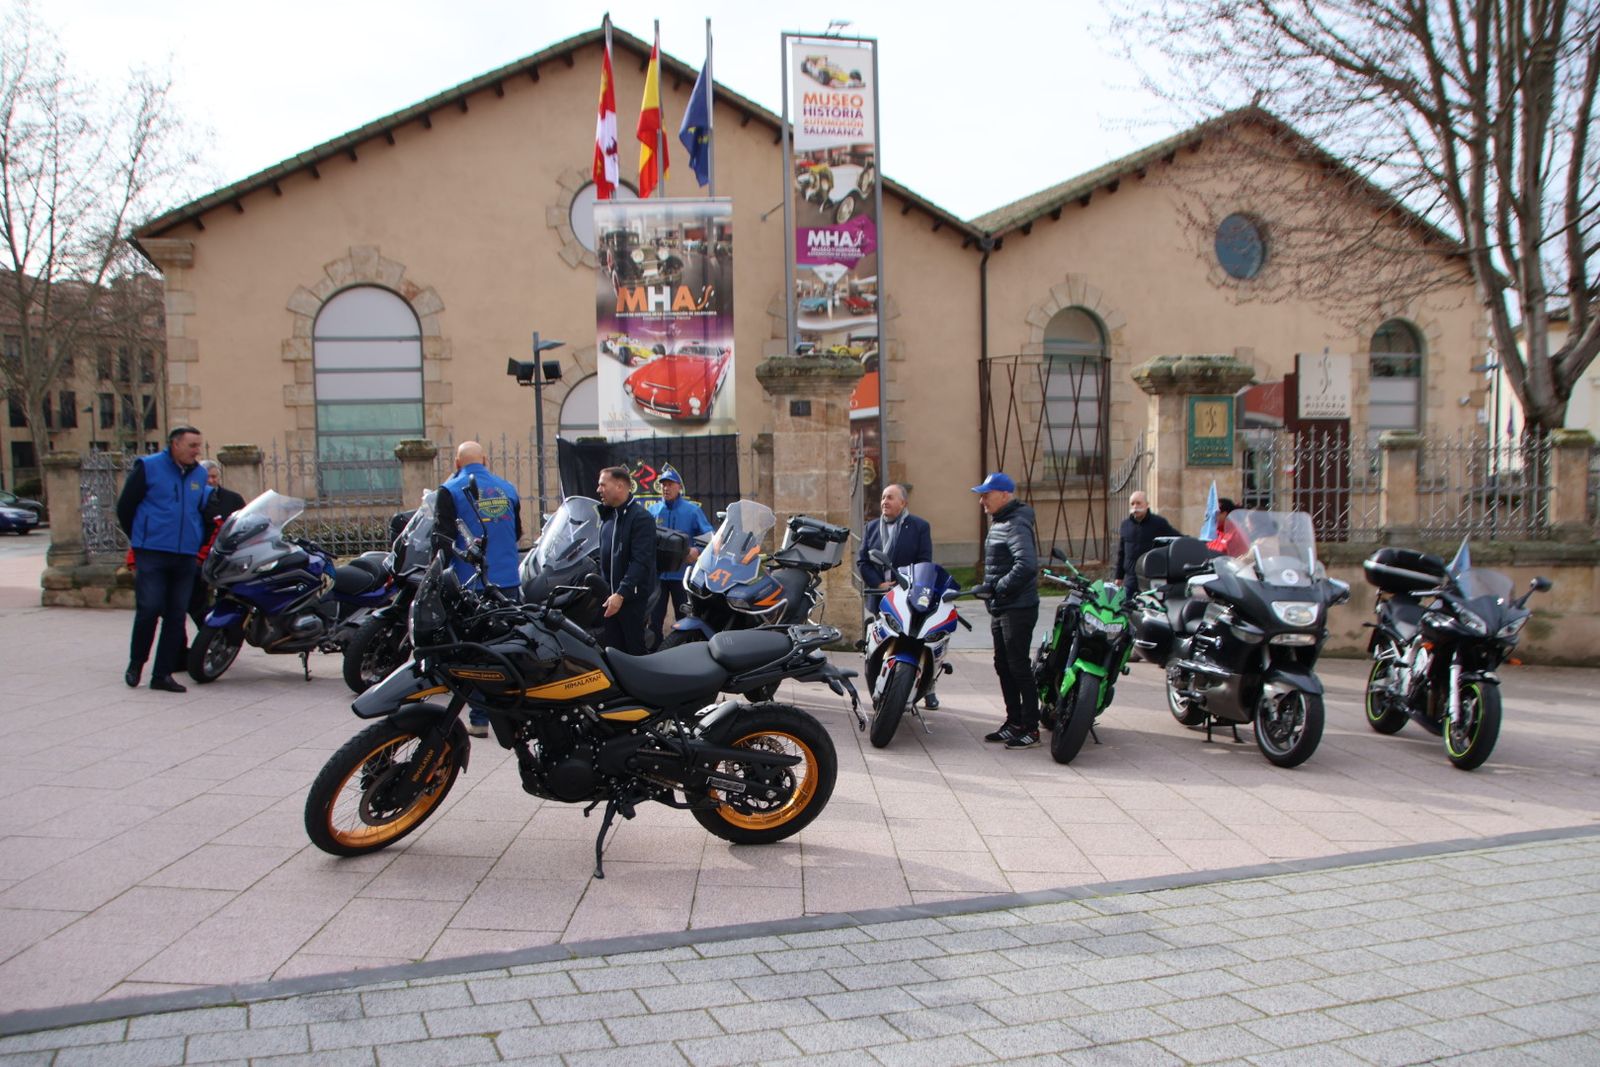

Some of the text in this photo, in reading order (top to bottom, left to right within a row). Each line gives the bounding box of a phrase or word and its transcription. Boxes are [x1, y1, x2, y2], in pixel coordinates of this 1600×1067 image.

[803, 92, 864, 108] MUSEO
[803, 106, 864, 118] HISTORIA
[803, 126, 864, 136] SALAMANCA
[564, 675, 601, 690] HIMALAYAN
